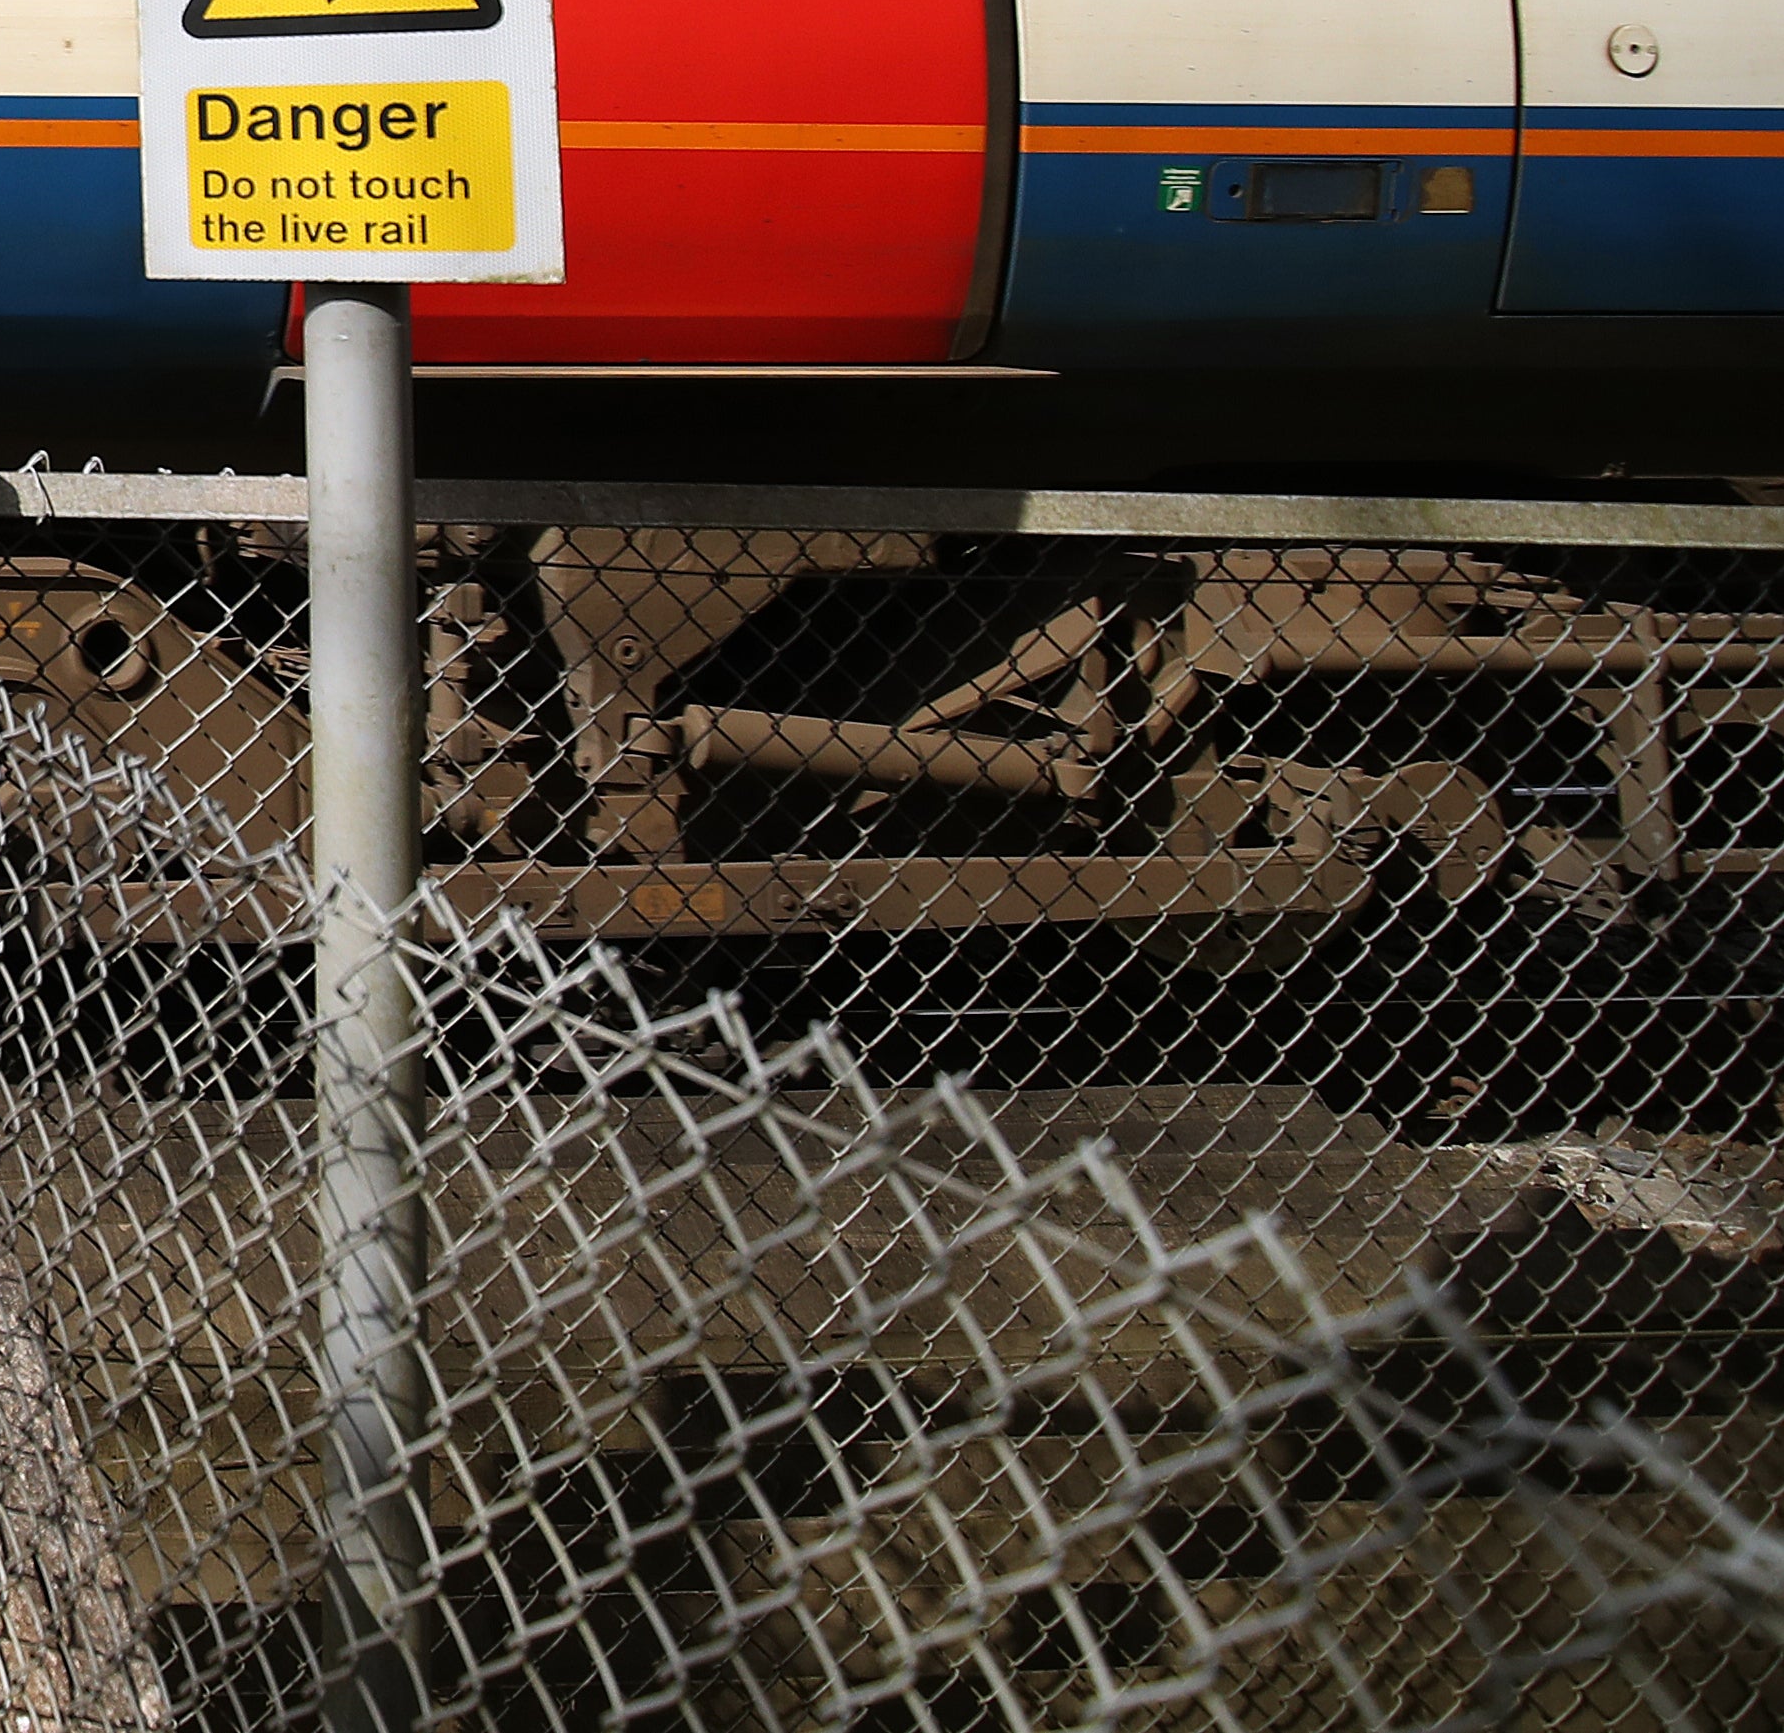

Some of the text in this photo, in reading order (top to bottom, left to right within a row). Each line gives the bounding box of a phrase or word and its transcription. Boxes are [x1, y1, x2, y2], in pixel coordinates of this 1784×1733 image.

[196, 92, 449, 152] Danger
[202, 167, 471, 201] Do not touch
[201, 212, 428, 246] the live rail
